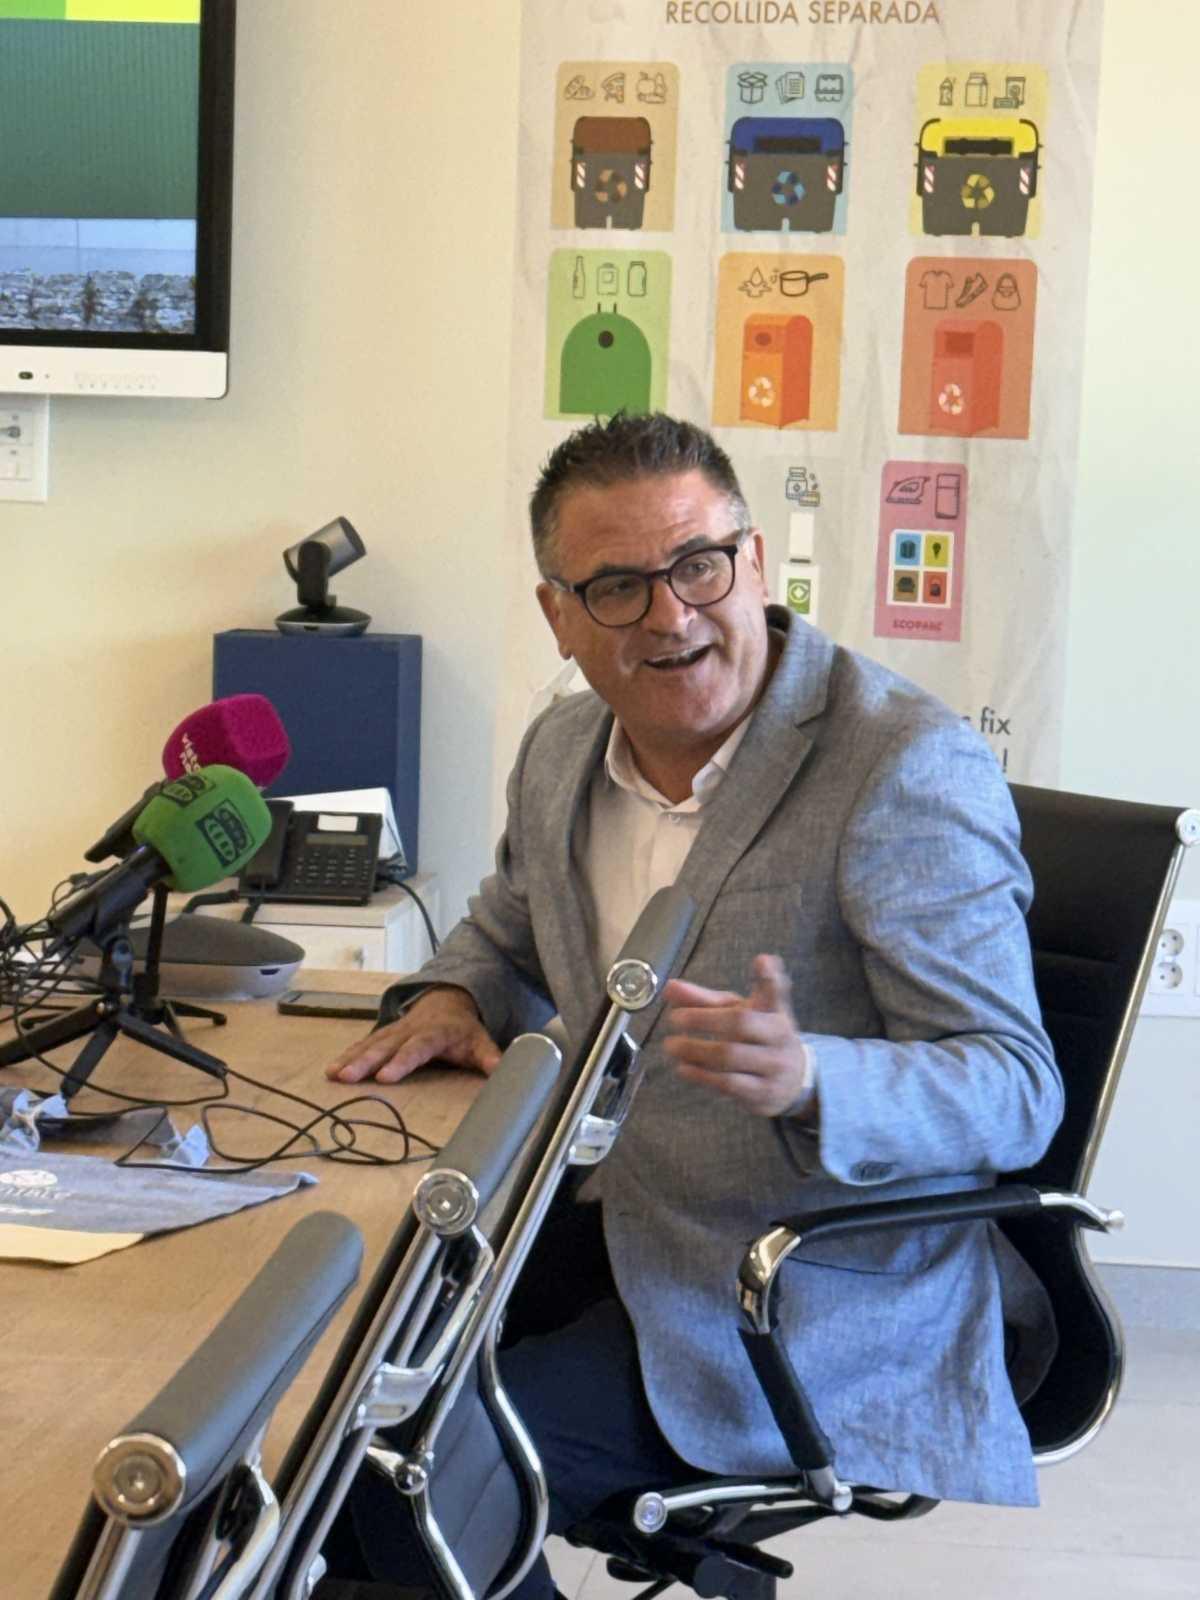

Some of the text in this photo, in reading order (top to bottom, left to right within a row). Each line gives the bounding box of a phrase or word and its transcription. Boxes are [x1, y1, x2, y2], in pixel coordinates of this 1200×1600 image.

[666, 1, 940, 24] RECOLLIDA SEPARADA
[981, 706, 1010, 735] fix
